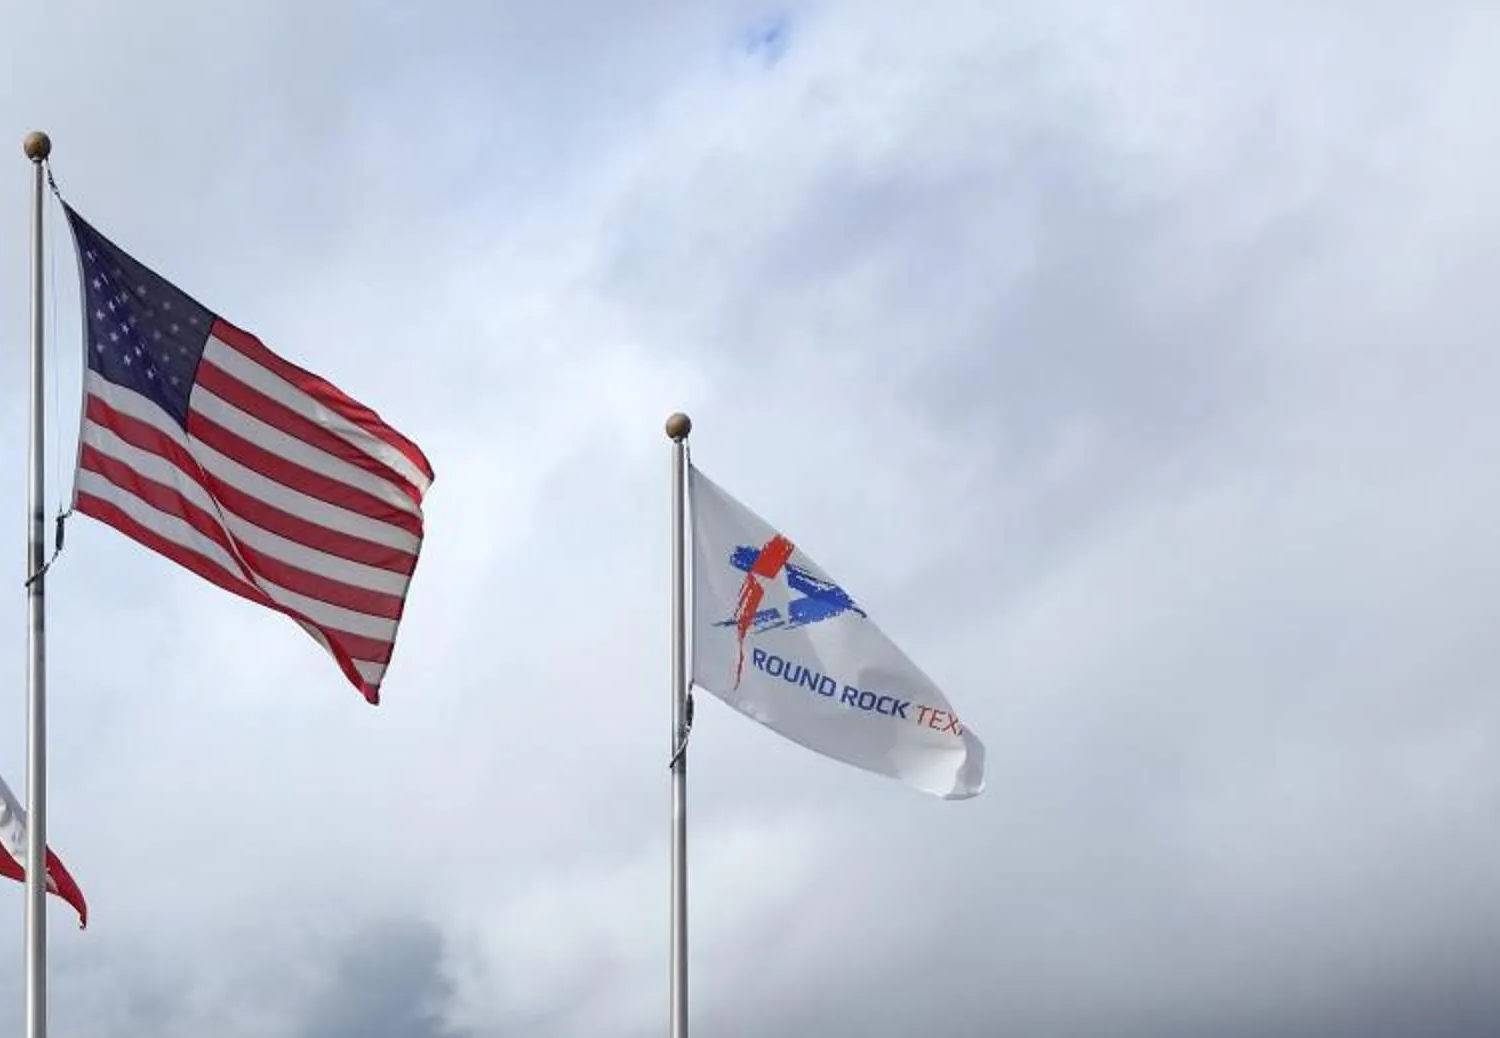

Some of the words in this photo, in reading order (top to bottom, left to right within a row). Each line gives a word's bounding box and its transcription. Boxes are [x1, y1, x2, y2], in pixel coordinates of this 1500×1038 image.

[752, 648, 837, 698] ROUND
[841, 685, 910, 720] ROCK
[917, 704, 963, 736] TEX
